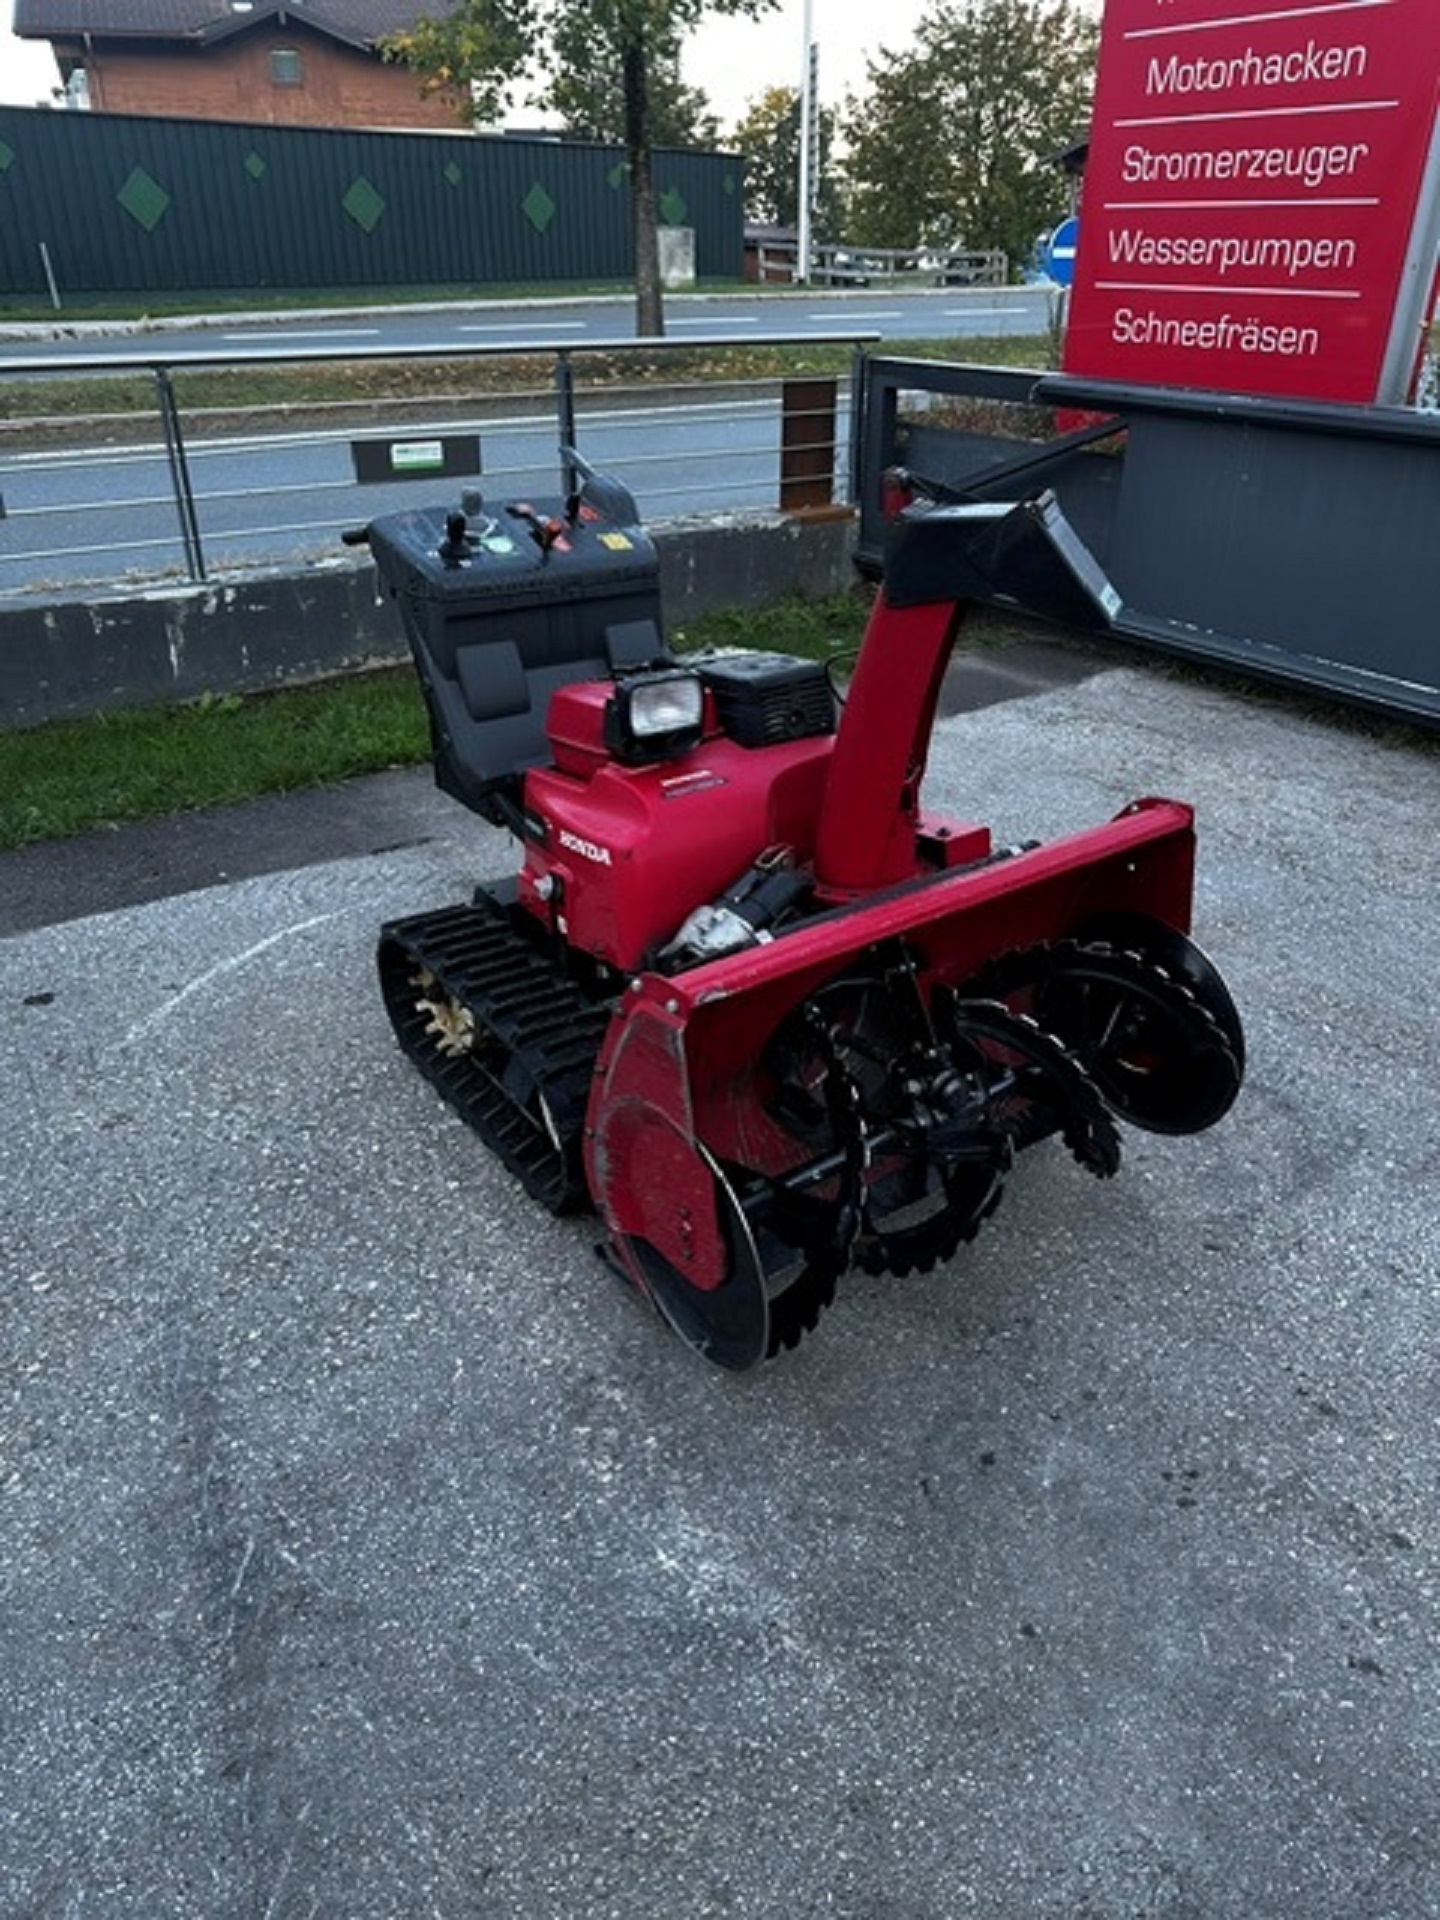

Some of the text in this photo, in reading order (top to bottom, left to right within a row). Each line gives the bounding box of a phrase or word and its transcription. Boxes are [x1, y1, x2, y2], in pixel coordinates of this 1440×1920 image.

[1145, 40, 1367, 95] Motorhacken
[1121, 143, 1369, 187] Stromerzeuger
[1108, 229, 1356, 277] Wasserpumpen
[1112, 307, 1319, 355] Schneefräsen
